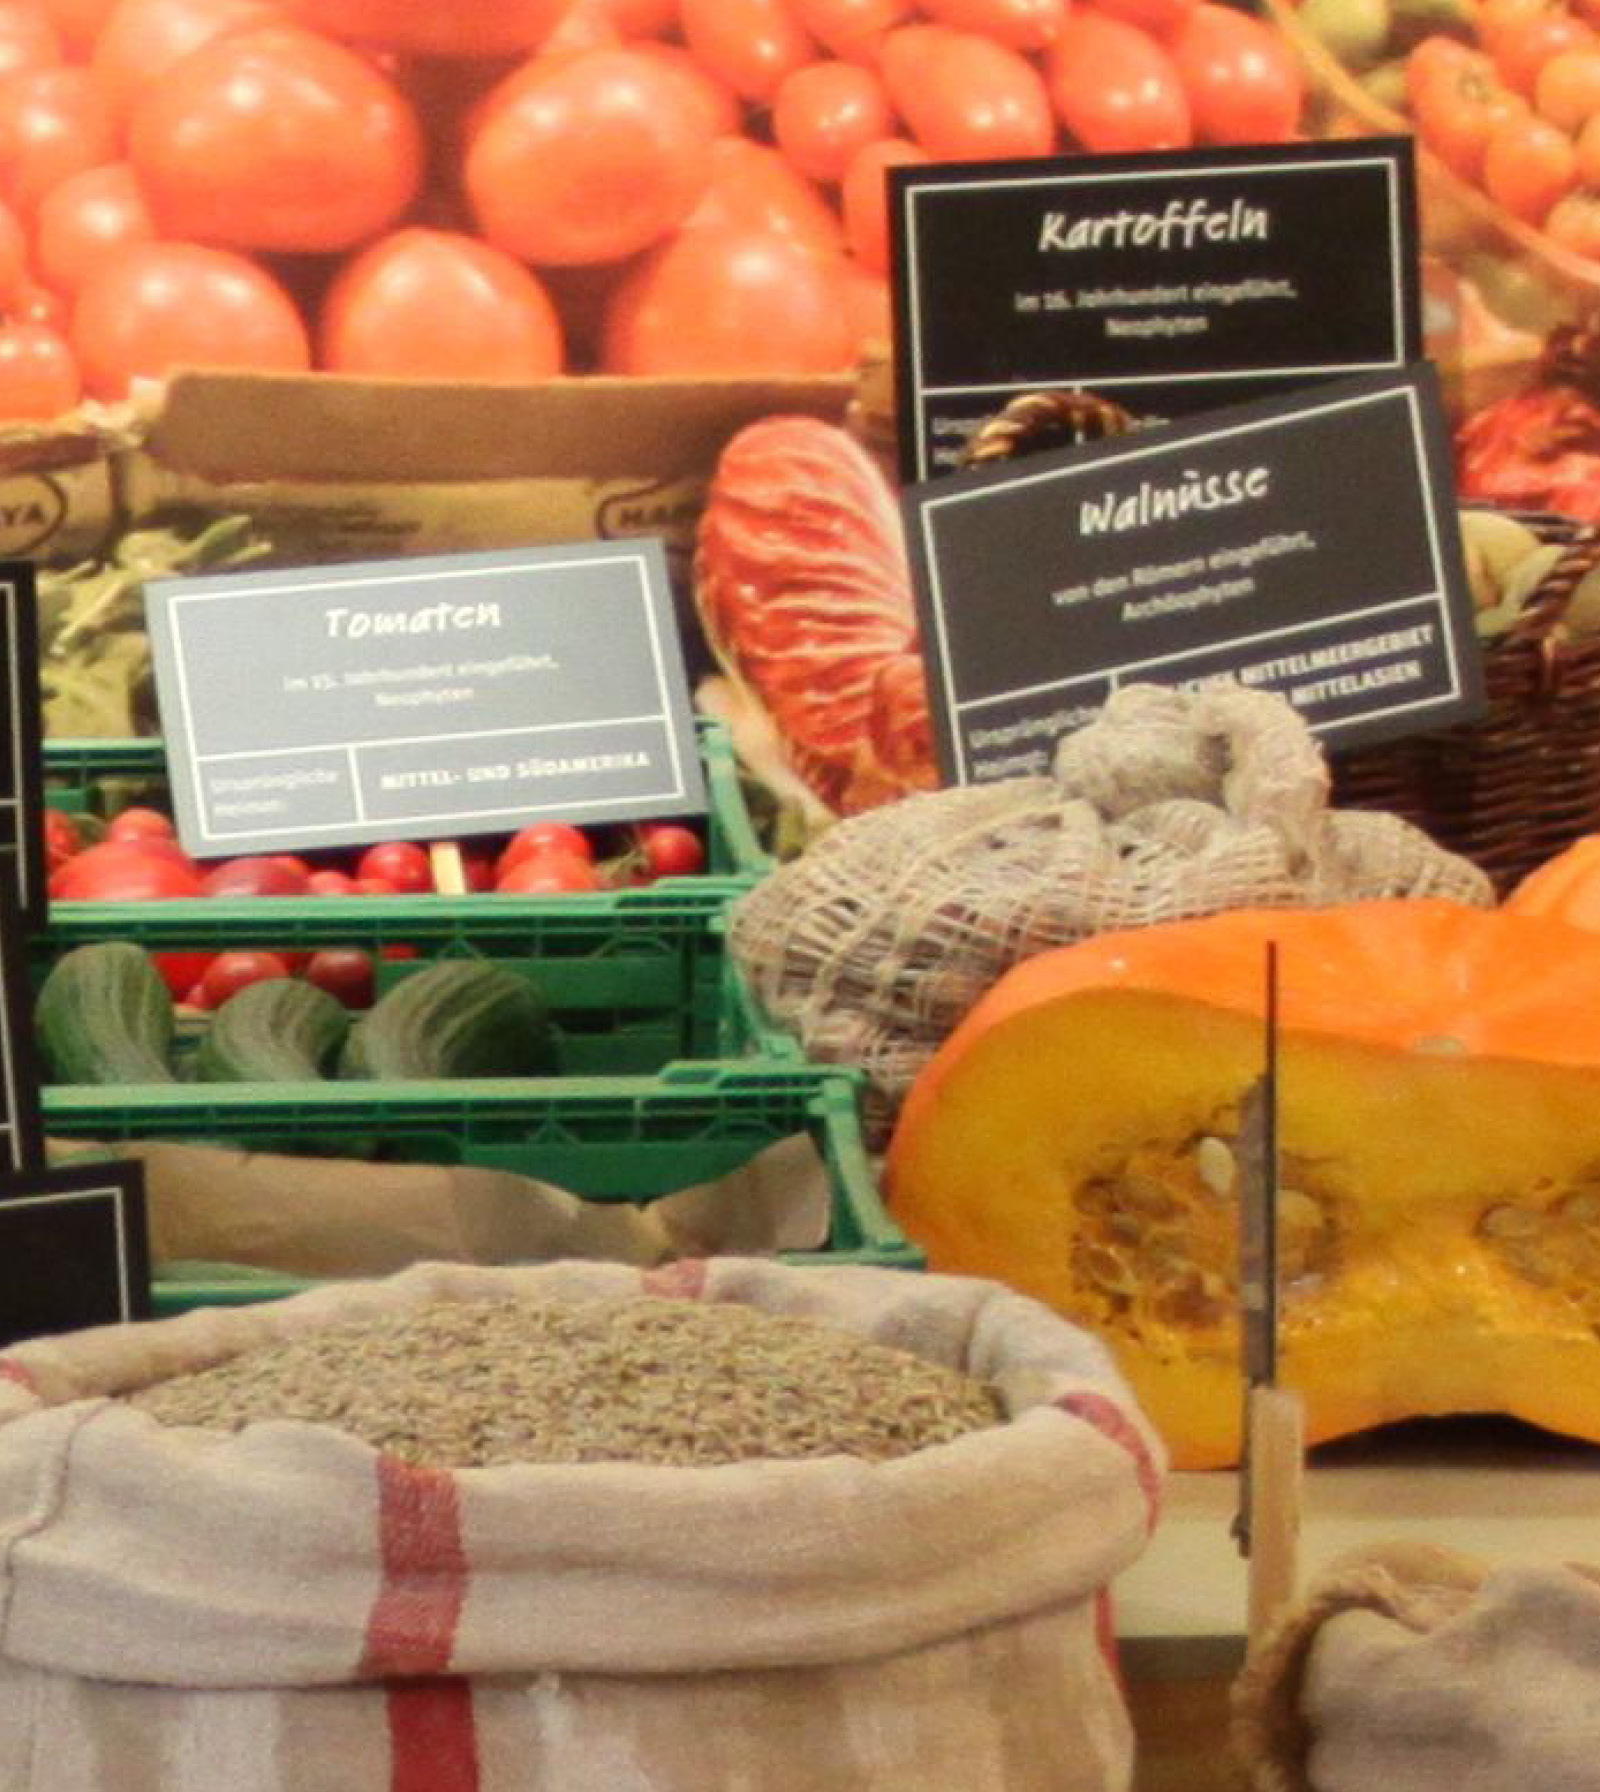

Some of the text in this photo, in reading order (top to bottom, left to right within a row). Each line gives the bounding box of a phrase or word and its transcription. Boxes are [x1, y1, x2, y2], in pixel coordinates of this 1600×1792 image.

[1038, 199, 1268, 252] Kartoffeln
[1078, 466, 1270, 535] Walnüsse
[323, 599, 502, 639] Tomaten
[1291, 661, 1423, 706] MITTELASIEN
[380, 750, 651, 790] MITTEL- UND SÜDAMERIKA
